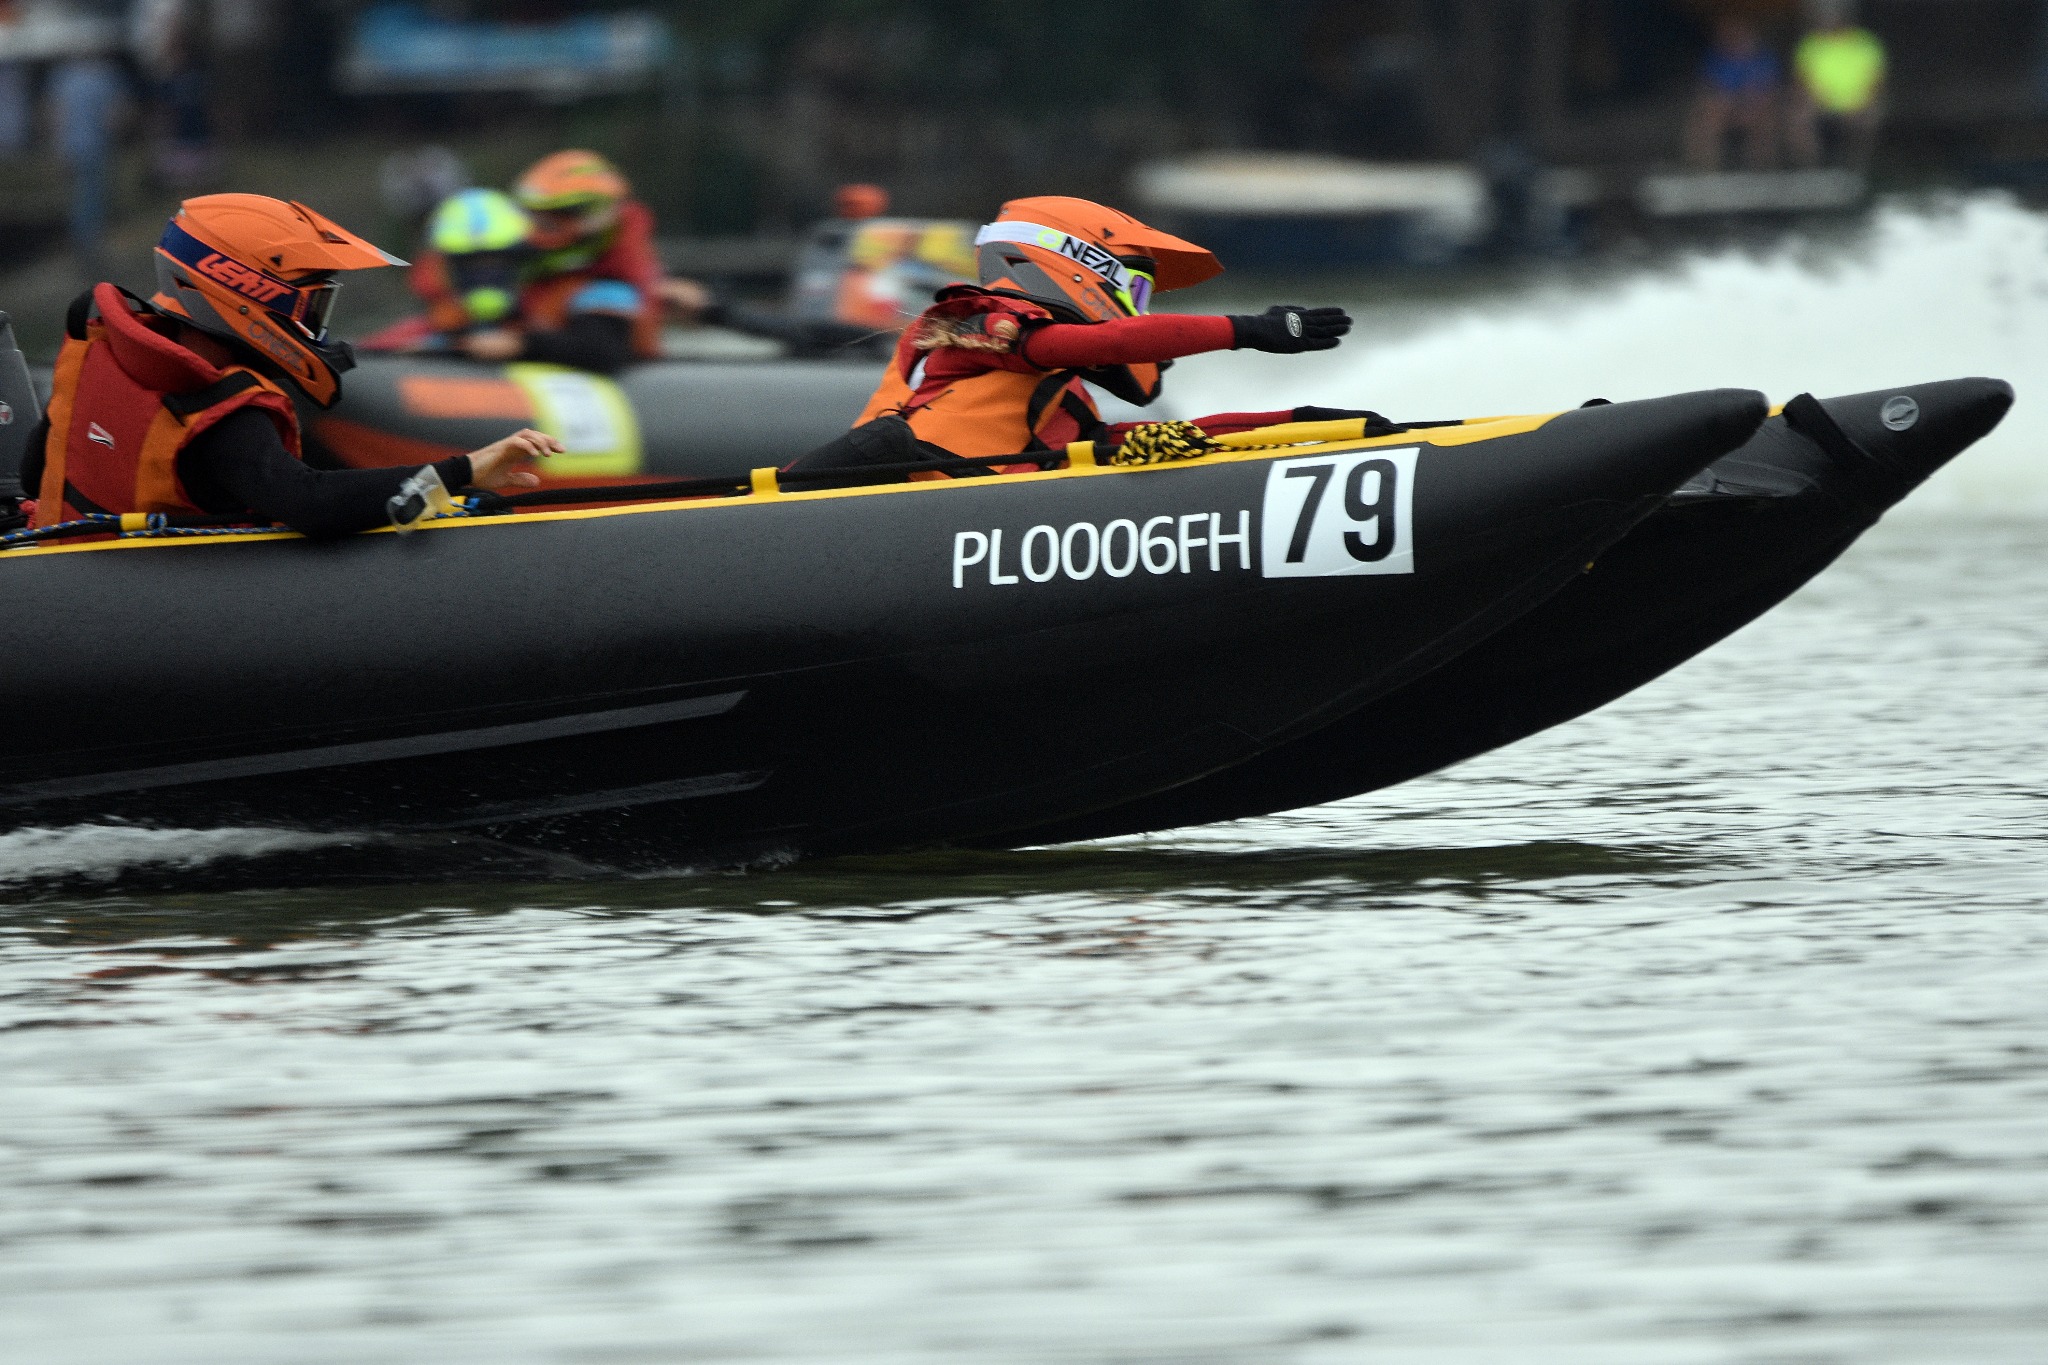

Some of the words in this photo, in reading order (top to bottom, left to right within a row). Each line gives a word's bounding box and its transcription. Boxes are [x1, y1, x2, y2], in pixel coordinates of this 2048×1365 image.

[197, 253, 293, 303] LEATT
[952, 509, 1251, 589] PL0006FH
[1284, 458, 1397, 563] 79
